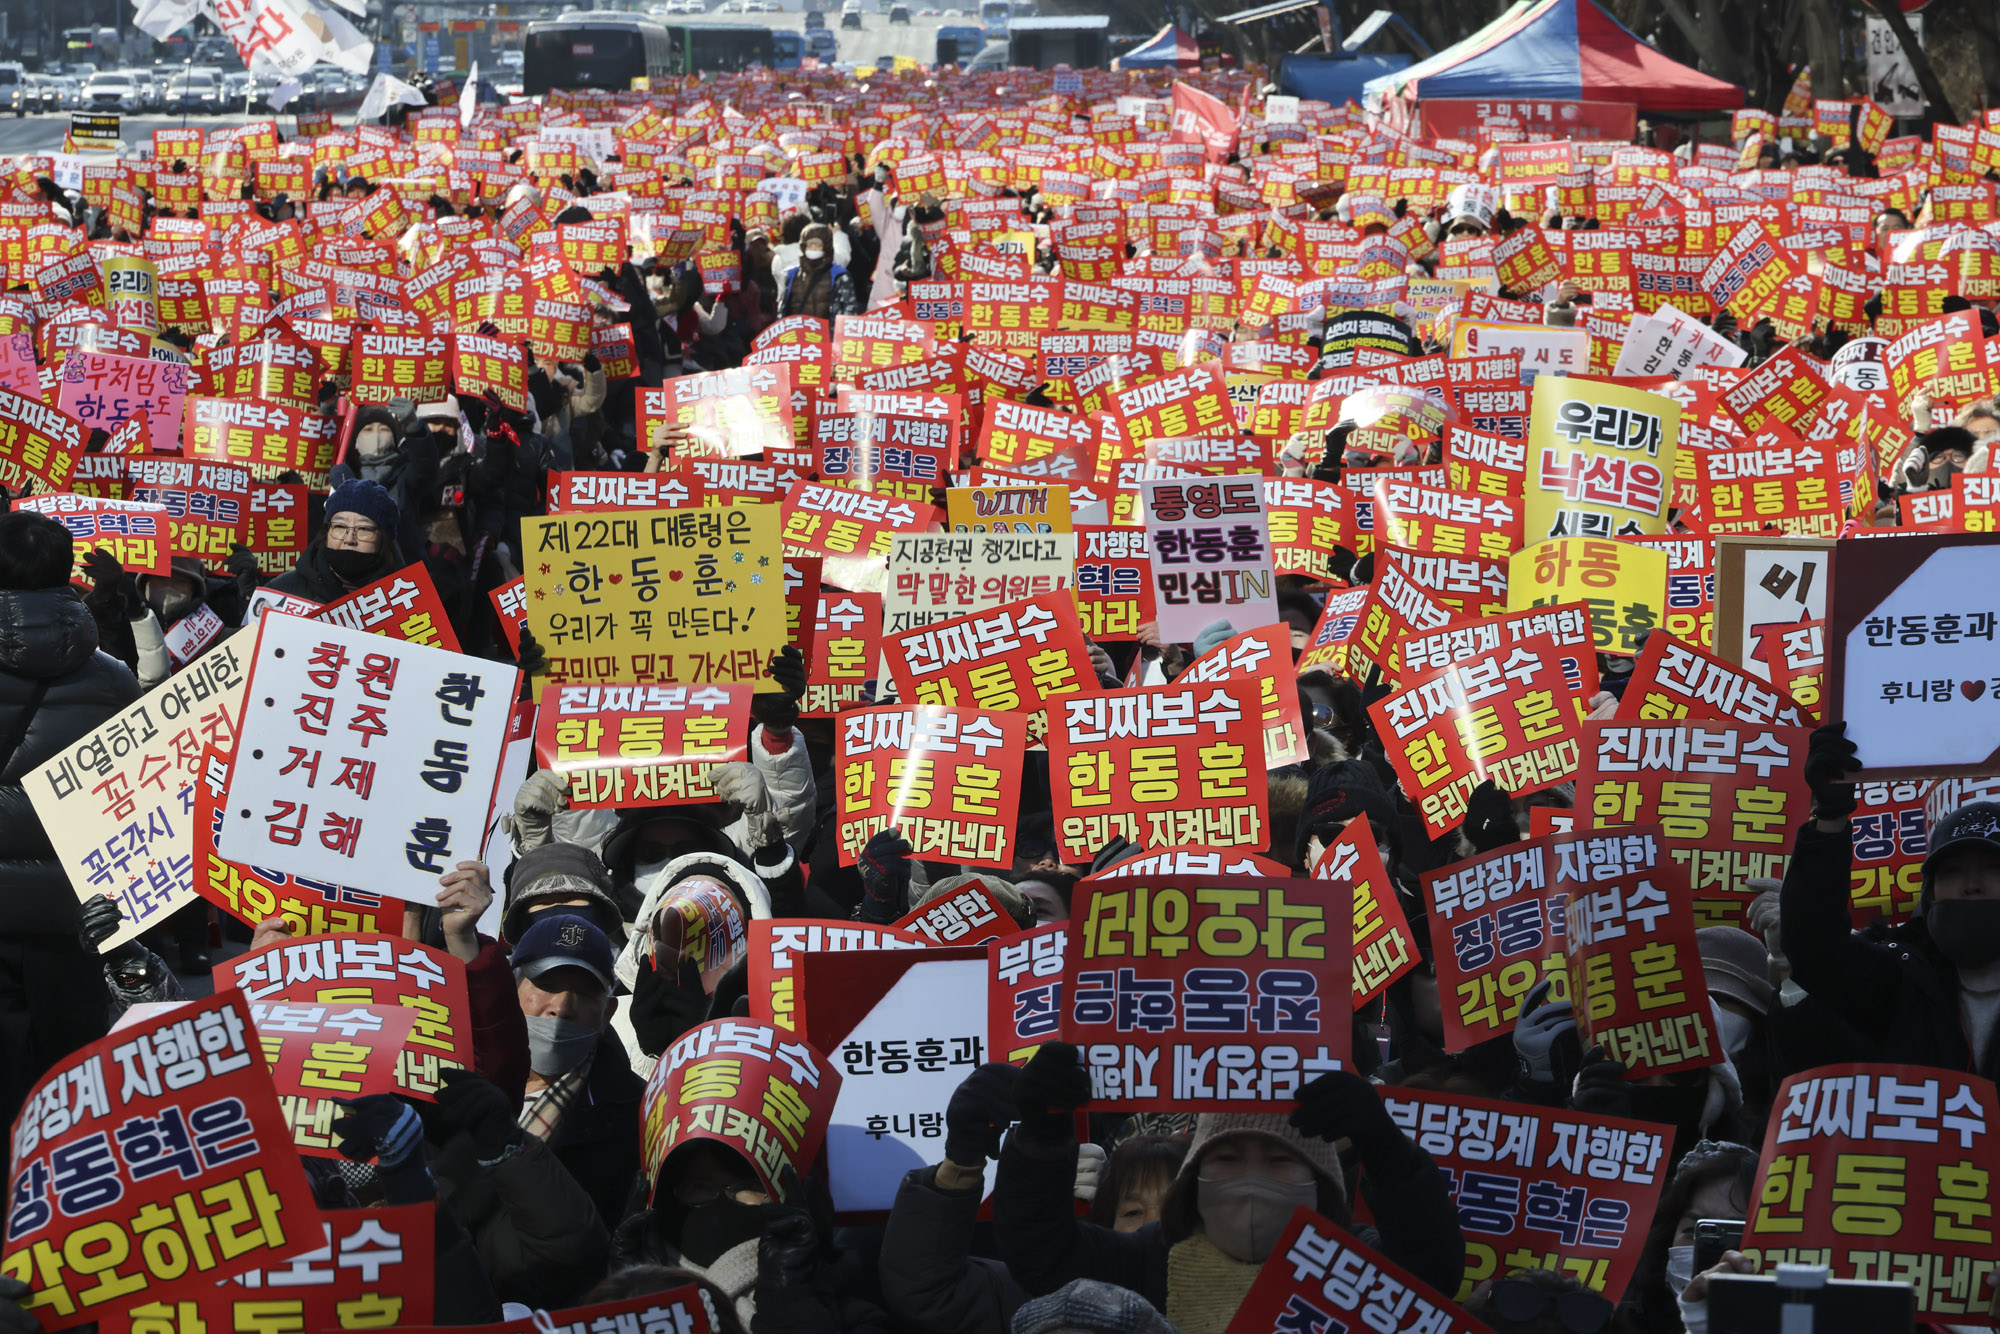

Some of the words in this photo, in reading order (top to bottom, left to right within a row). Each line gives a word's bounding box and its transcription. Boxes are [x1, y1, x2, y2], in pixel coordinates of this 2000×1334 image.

[156, 130, 199, 142] 진짜보수
[155, 173, 198, 186] 진짜보수
[258, 162, 304, 174] 진짜보수
[1853, 177, 1902, 196] 진짜보수
[1933, 186, 1988, 200] 진짜보수
[1, 203, 49, 216] 진짜보수
[202, 201, 249, 214] 진짜보수
[1800, 205, 1837, 221] 부당징계
[1840, 208, 1869, 222] 자행한
[155, 219, 206, 234] 진짜보수
[241, 223, 292, 249] 진짜보수
[437, 220, 484, 236] 진짜보수
[562, 226, 618, 242] 진짜보수
[1065, 221, 1116, 240] 진짜보수
[1304, 226, 1358, 242] 진짜보수
[1572, 232, 1642, 250] 진짜보수
[340, 248, 389, 264] 진짜보수
[1059, 245, 1113, 262] 진짜보수
[1492, 227, 1536, 264] 진짜보수
[1700, 248, 1734, 292] 부당징계
[1728, 220, 1763, 253] 자행한
[404, 253, 470, 299] 진짜보수
[960, 253, 1023, 280] 진짜보수
[1240, 260, 1302, 276] 진짜보수
[1631, 252, 1675, 272] 부당징계
[1712, 242, 1774, 306] 장동혁은
[1822, 262, 1885, 293] 진짜보수
[333, 271, 378, 289] 부당징계
[454, 273, 522, 300] 진짜보수
[911, 282, 951, 300] 부당징계
[971, 282, 1050, 302] 진짜보수
[1064, 282, 1134, 308] 진짜보수
[1156, 279, 1190, 295] 자행한
[359, 302, 419, 327] 진짜보수
[534, 300, 591, 322] 진짜보수
[56, 326, 141, 352] 진짜보수
[361, 333, 446, 355] 진짜보수
[756, 316, 822, 349] 진짜보수
[844, 319, 925, 340] 진짜보수
[1041, 336, 1089, 354] 부당징계
[1092, 334, 1132, 352] 자행한
[1886, 315, 1970, 369] 진짜보수
[238, 344, 313, 368] 진짜보수
[456, 334, 523, 363] 진짜보수
[1231, 344, 1310, 364] 진짜보수
[86, 356, 157, 397] 부처님
[862, 360, 952, 391] 진짜보수
[964, 350, 1038, 390] 진짜보수
[1074, 352, 1152, 397] 진짜보수
[1401, 358, 1446, 385] 자행한
[1476, 364, 1517, 382] 자행한
[355, 384, 396, 402] 우리가
[400, 384, 446, 402] 지켜낸다
[1117, 368, 1213, 418] 진짜보수
[1464, 391, 1526, 412] 부당징계
[1724, 358, 1796, 414] 진짜보수
[0, 393, 82, 451] 진짜보수
[196, 399, 290, 431] 진짜보수
[994, 401, 1092, 444] 진짜보수
[1555, 401, 1661, 456] 우리가
[818, 419, 886, 442] 부당징계
[892, 419, 949, 449] 자행한
[823, 448, 938, 480] 장동혁은
[1156, 438, 1262, 464] 진짜보수
[1706, 449, 1824, 481] 진짜보수
[128, 459, 194, 487] 부당징계
[199, 464, 250, 494] 자행한
[570, 476, 690, 508] 진짜보수
[693, 461, 806, 492] 진짜보수
[1539, 448, 1664, 517] 낙선은
[797, 483, 916, 529] 진짜보수
[972, 487, 1048, 517] WITH
[1152, 482, 1261, 522] 통영도
[1389, 487, 1513, 526] 진짜보수
[538, 520, 638, 554] 제22대
[651, 511, 751, 549] 대통령은
[1153, 526, 1264, 564] 한동훈
[895, 538, 973, 564] 지공천권
[549, 612, 618, 646] 우리가
[629, 609, 652, 642] 꼭
[668, 606, 756, 639] 만든다!
[900, 603, 1059, 677] 진짜보수
[1864, 612, 1998, 647] 한동훈과
[1404, 623, 1501, 671] 부당징계
[557, 685, 731, 714] 진짜보수
[1383, 646, 1545, 740] 진짜보수
[1880, 678, 1956, 705] 후니랑
[44, 703, 160, 801] 비열하고
[160, 645, 243, 723] 야비한
[1064, 688, 1243, 745] 진짜보수
[843, 710, 1005, 757] 진짜보수
[1490, 737, 1580, 794] 지켜낸다
[1596, 726, 1791, 778] 진짜보수
[80, 805, 176, 887] 꼭두각시
[897, 816, 1007, 862] 지켜낸다
[1062, 812, 1140, 857] 우리가
[1146, 804, 1262, 850] 지켜낸다
[1432, 848, 1547, 921] 부당징계
[1554, 834, 1659, 884] 자행한
[1081, 886, 1326, 960] 각오하라
[234, 938, 446, 1002] 진짜보수
[1072, 967, 1321, 1035] 장동혁은
[112, 1003, 252, 1106] 자행한
[648, 1022, 821, 1110] 진짜보수
[842, 1035, 985, 1076] 한동훈과
[1775, 1072, 1988, 1149] 진짜보수
[864, 1113, 945, 1141] 후니랑
[1546, 1120, 1664, 1185] 자행한
[0, 1168, 288, 1319] 각오하라
